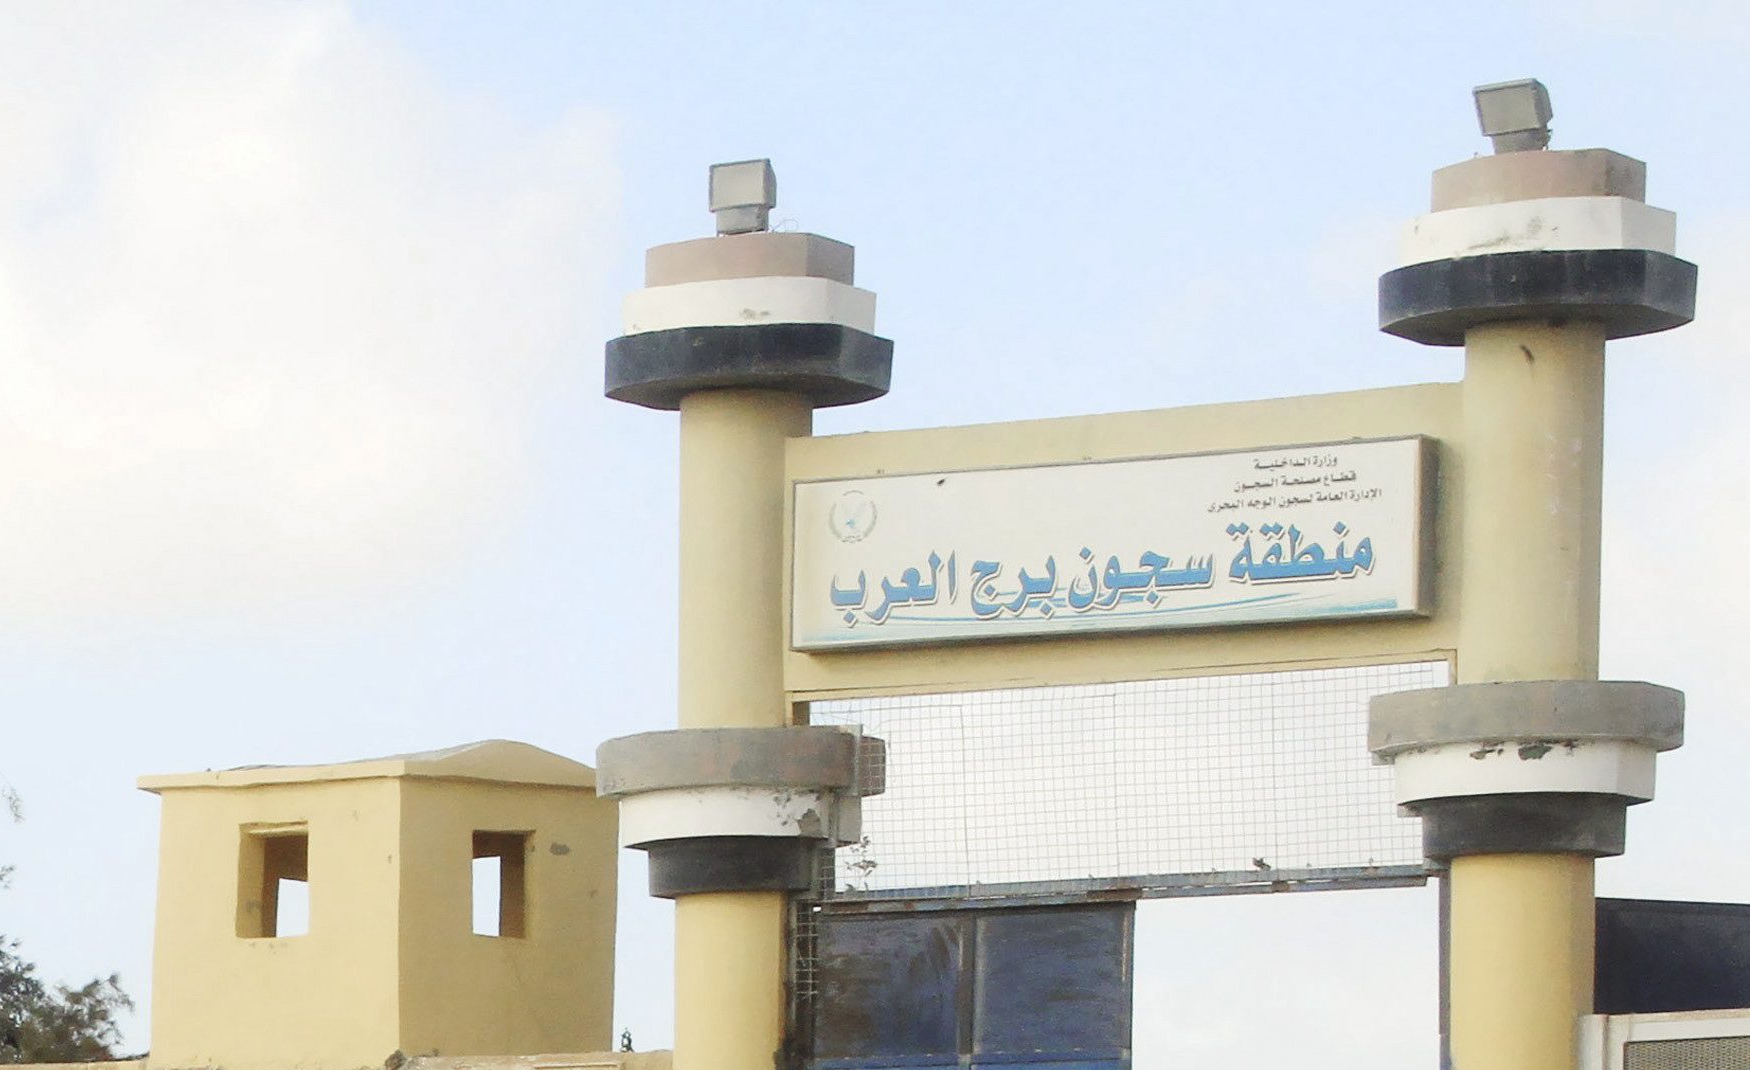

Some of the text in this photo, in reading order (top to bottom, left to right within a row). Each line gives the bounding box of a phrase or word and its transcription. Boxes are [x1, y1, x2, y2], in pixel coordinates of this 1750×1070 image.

[1252, 453, 1338, 472] وزارة الداخلية
[1234, 478, 1279, 494] السجون
[1248, 496, 1277, 509] الوجه
[1279, 496, 1312, 508] لسجون
[1315, 491, 1348, 502] العامة
[829, 521, 1375, 628] منطقة سجون برج العرب
